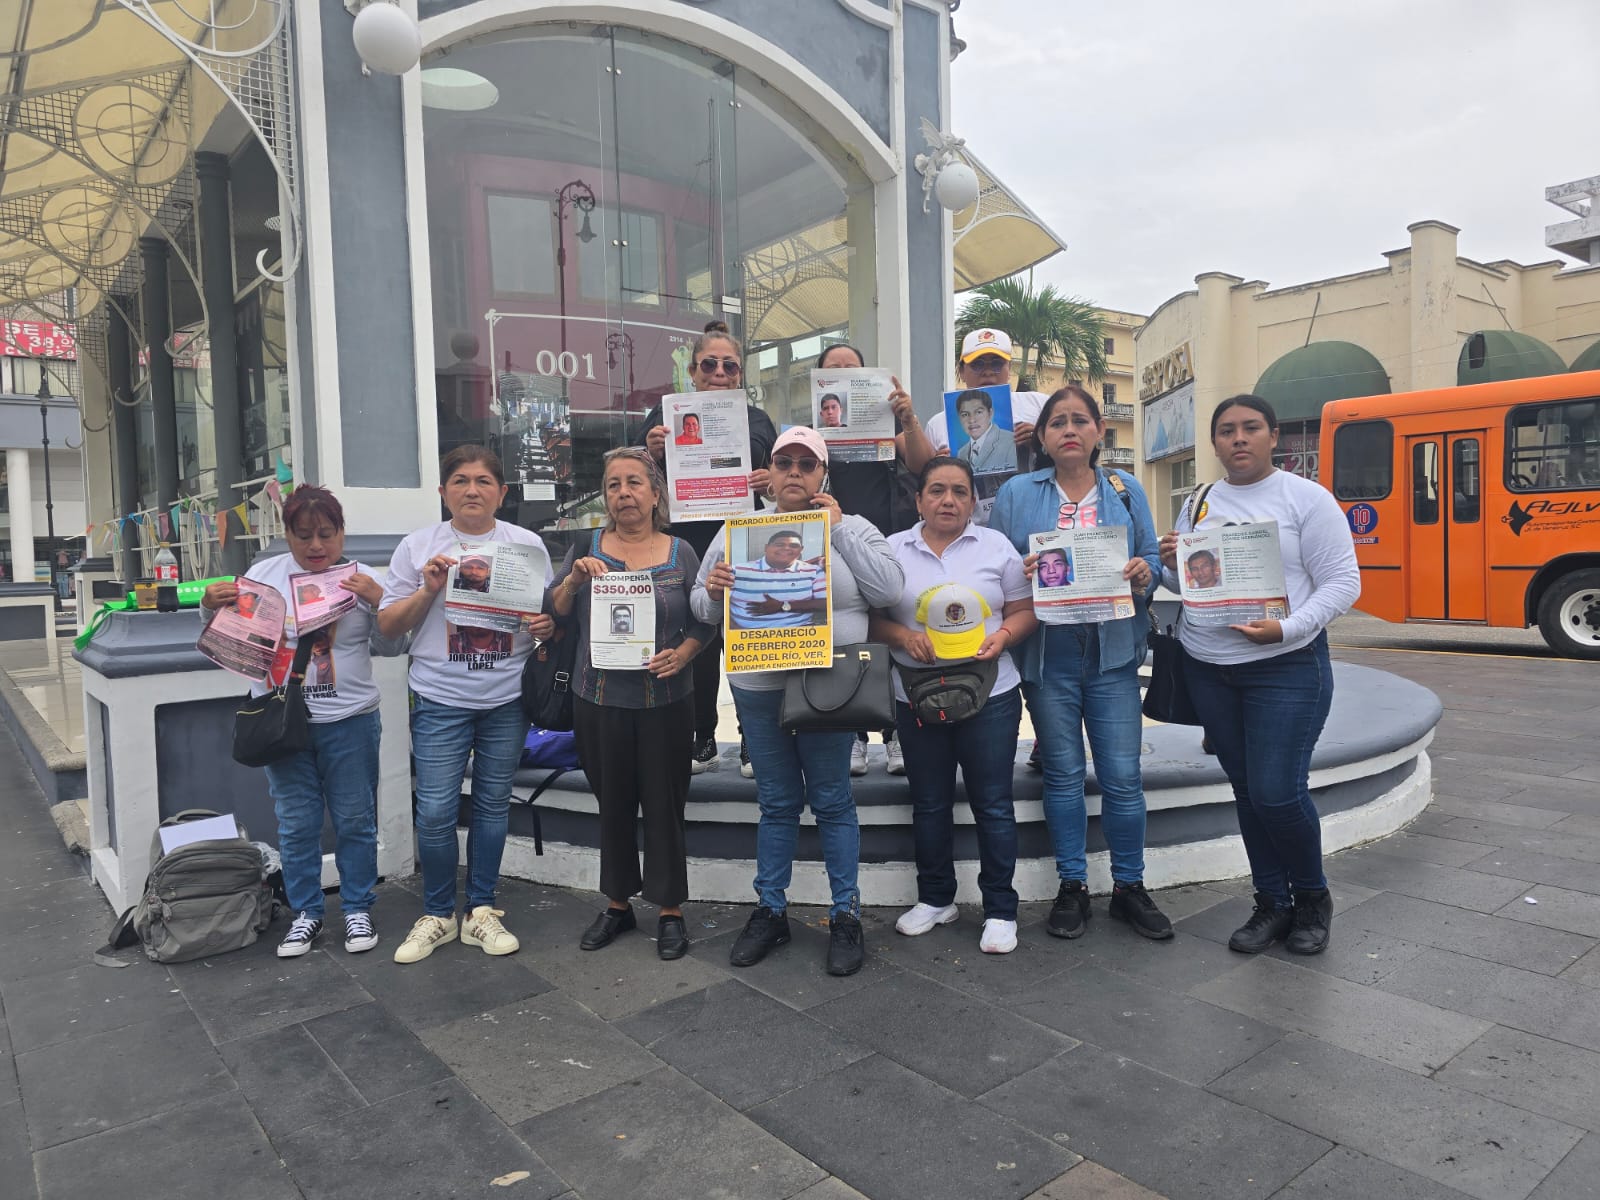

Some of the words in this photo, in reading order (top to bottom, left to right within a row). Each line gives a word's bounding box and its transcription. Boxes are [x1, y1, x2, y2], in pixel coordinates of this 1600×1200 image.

[535, 349, 596, 380] 001
[730, 518, 764, 526] RICARDO
[790, 512, 823, 522] MONTOR
[1352, 508, 1371, 526] 10
[593, 574, 650, 582] RECOMPENSA
[593, 584, 652, 596] $350,000
[740, 626, 817, 640] DESAPARECIÓ
[731, 643, 745, 652] 06
[747, 641, 797, 651] FEBRERO
[798, 639, 826, 649] 2020
[448, 653, 478, 663] JORGE
[730, 654, 760, 663] BOCA
[761, 653, 780, 662] DEL
[782, 651, 802, 661] RÍO,
[803, 651, 826, 660] VER.
